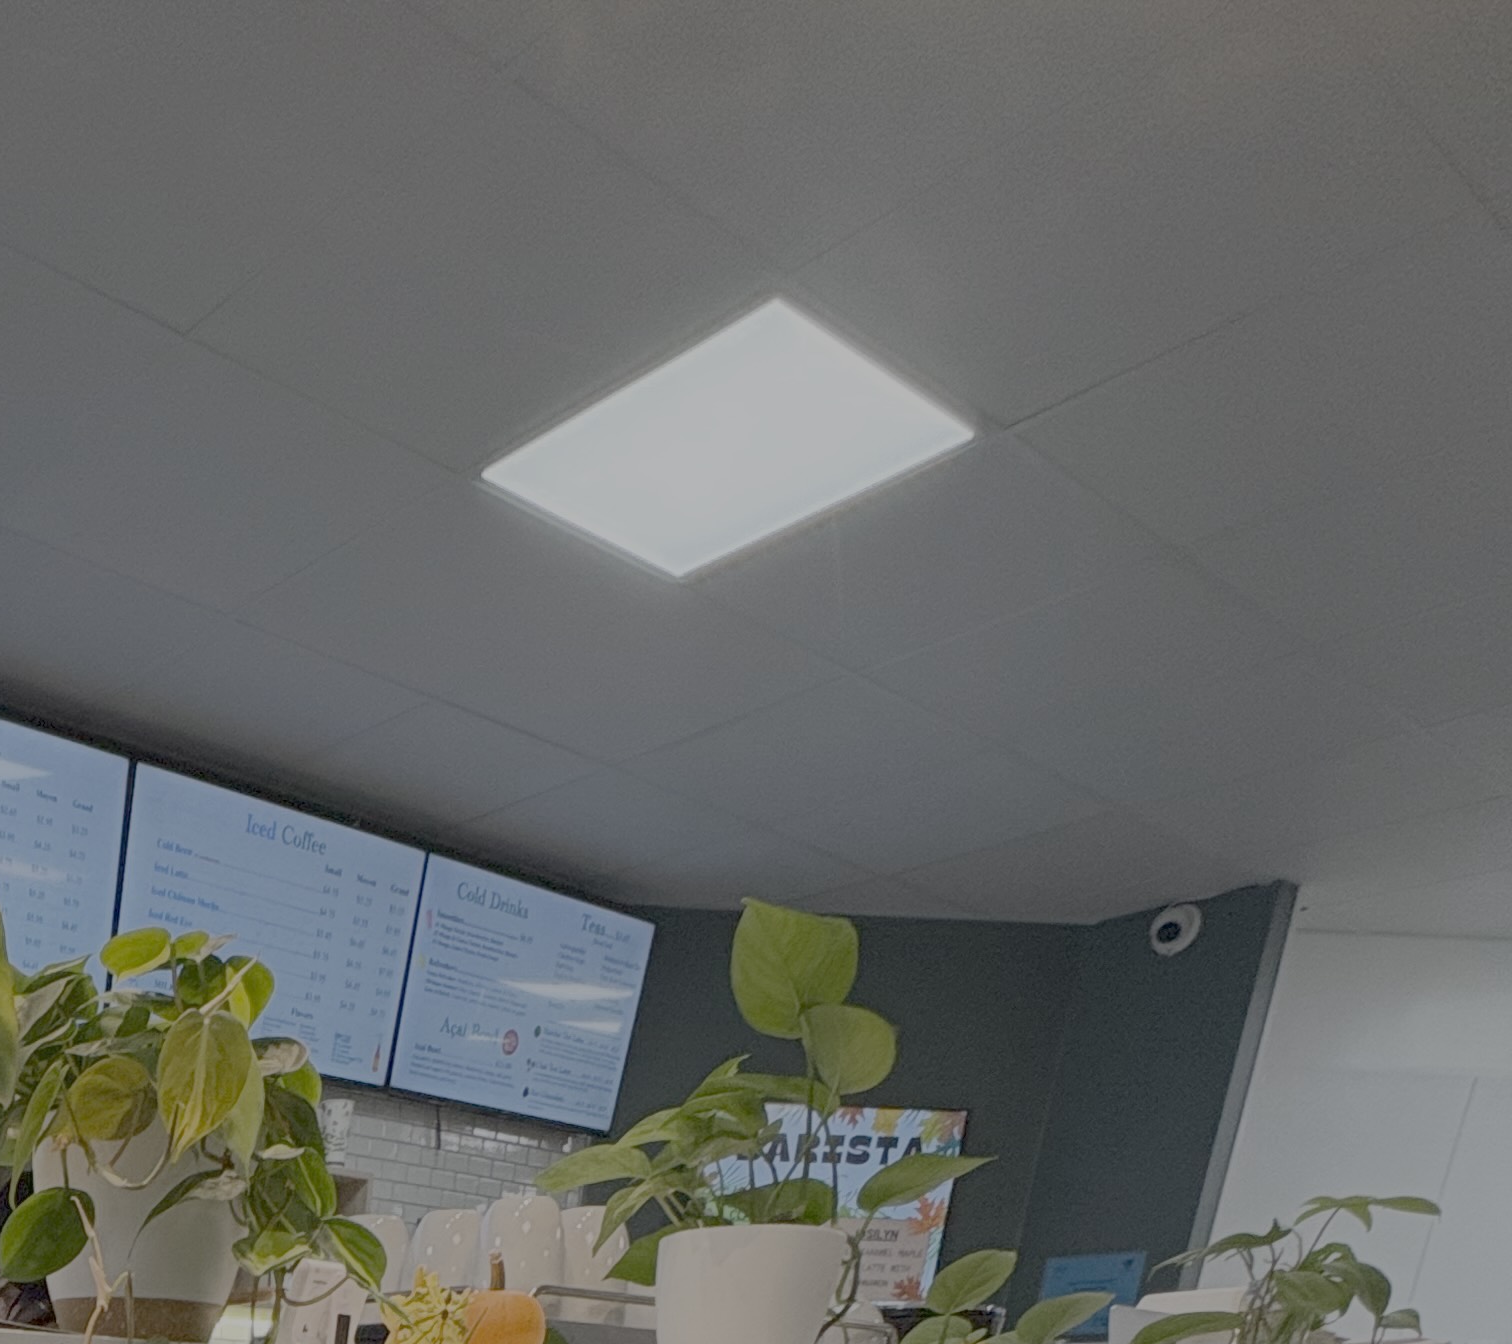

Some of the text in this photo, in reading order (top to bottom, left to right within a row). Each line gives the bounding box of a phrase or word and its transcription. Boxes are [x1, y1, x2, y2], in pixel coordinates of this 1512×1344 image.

[245, 813, 328, 856] Iced Coffee
[455, 881, 530, 919] Cold Drinks
[736, 1133, 924, 1165] ARISTA
